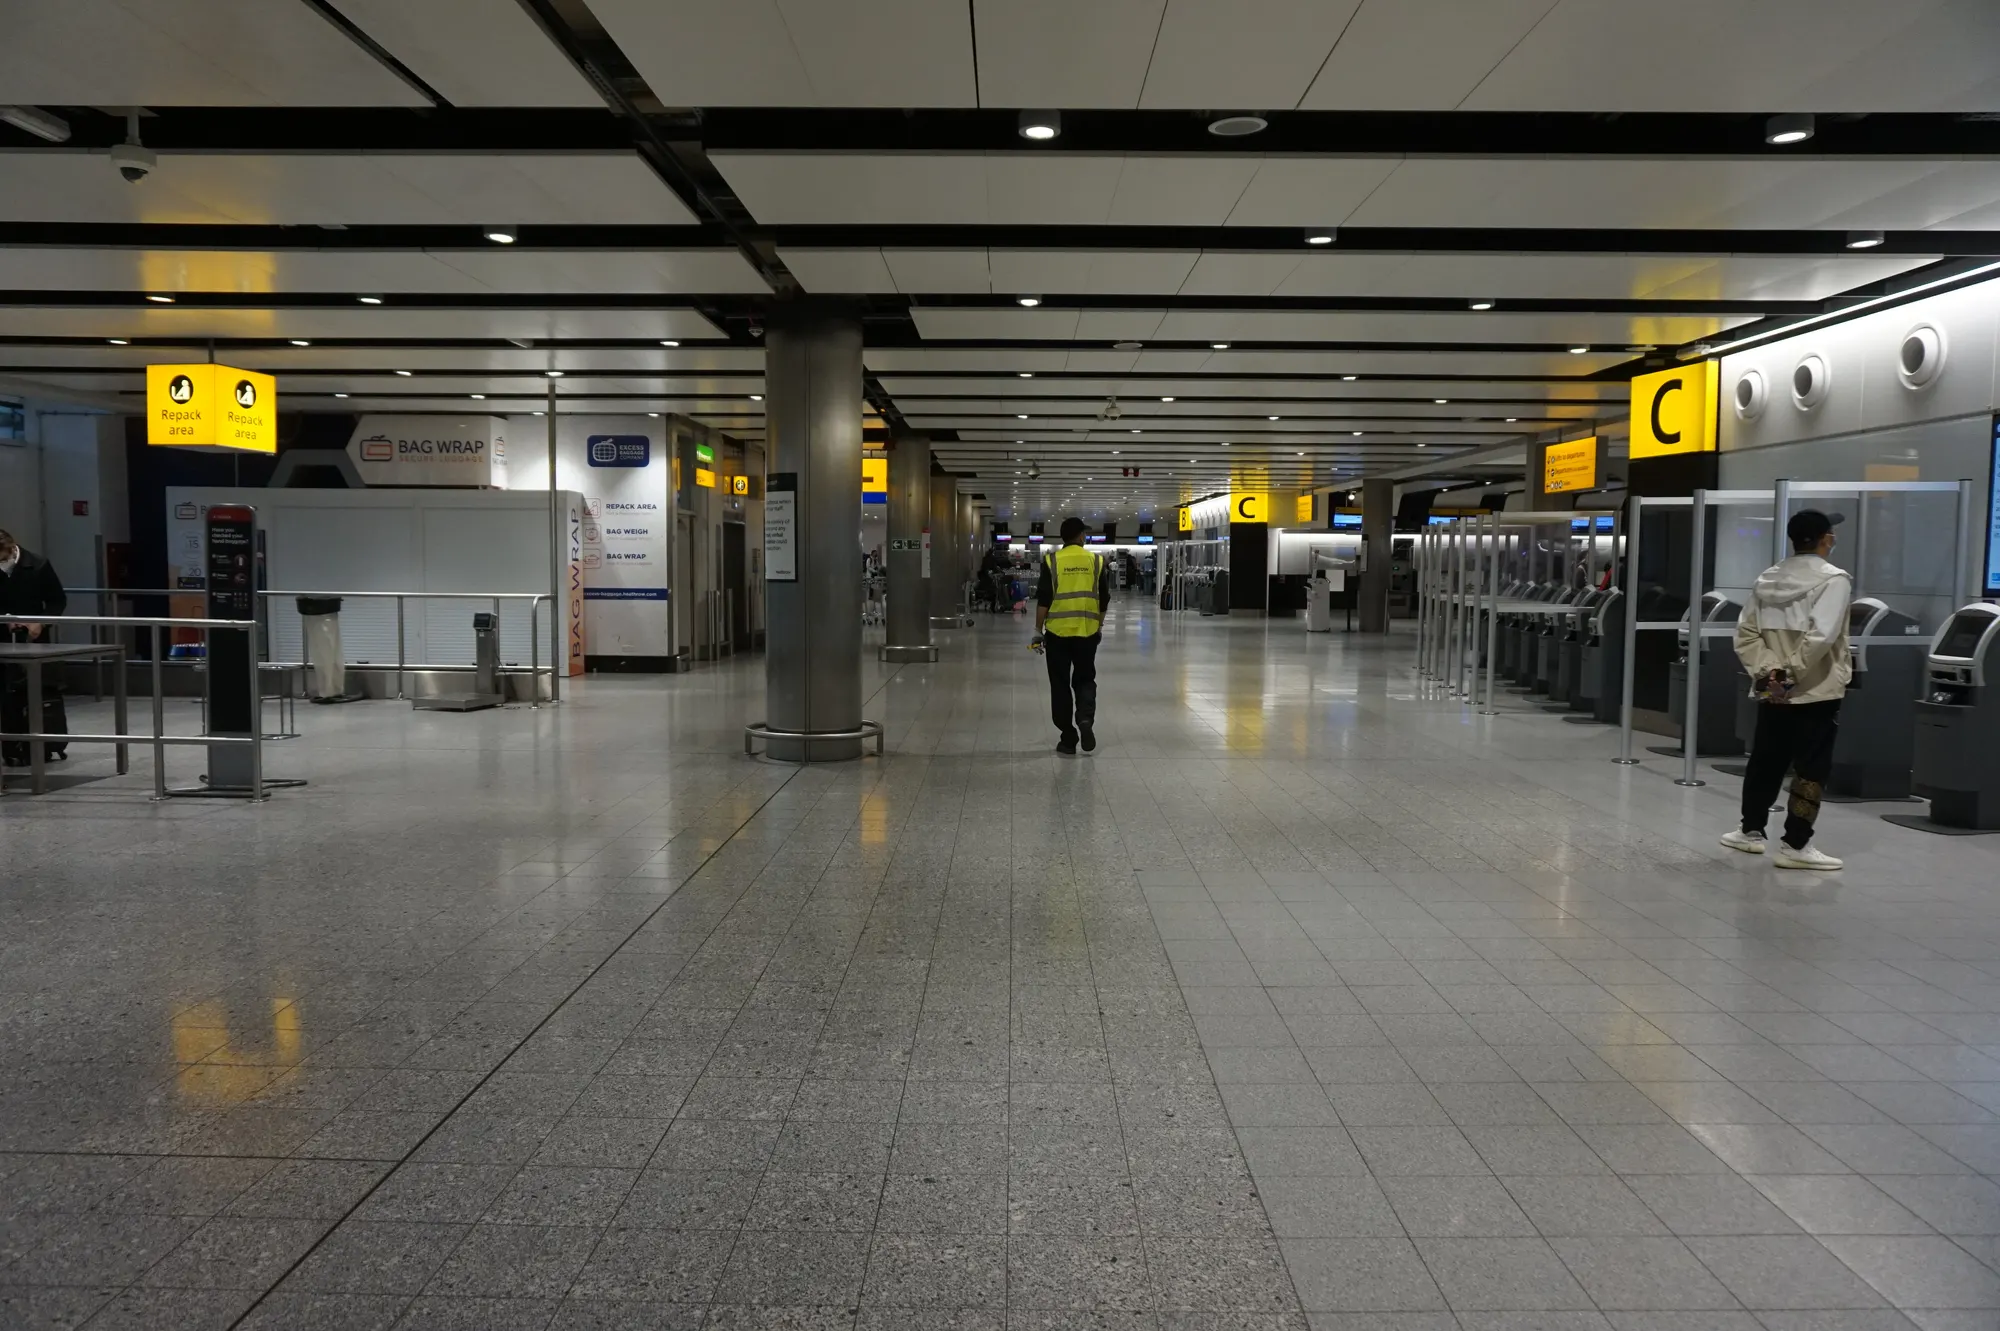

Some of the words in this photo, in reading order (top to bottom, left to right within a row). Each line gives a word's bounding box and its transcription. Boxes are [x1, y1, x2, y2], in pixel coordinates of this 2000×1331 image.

[161, 410, 202, 422] Repack
[228, 411, 263, 427] Repack
[1651, 378, 1683, 445] C
[168, 426, 194, 435] area
[234, 429, 257, 440] area
[398, 440, 433, 454] BAG
[436, 440, 484, 454] WRAP
[1238, 496, 1256, 519] C
[1182, 511, 1187, 528] B
[188, 540, 199, 549] 15
[571, 508, 580, 591] WRAP
[188, 568, 202, 577] 20
[572, 598, 581, 659] BAG
